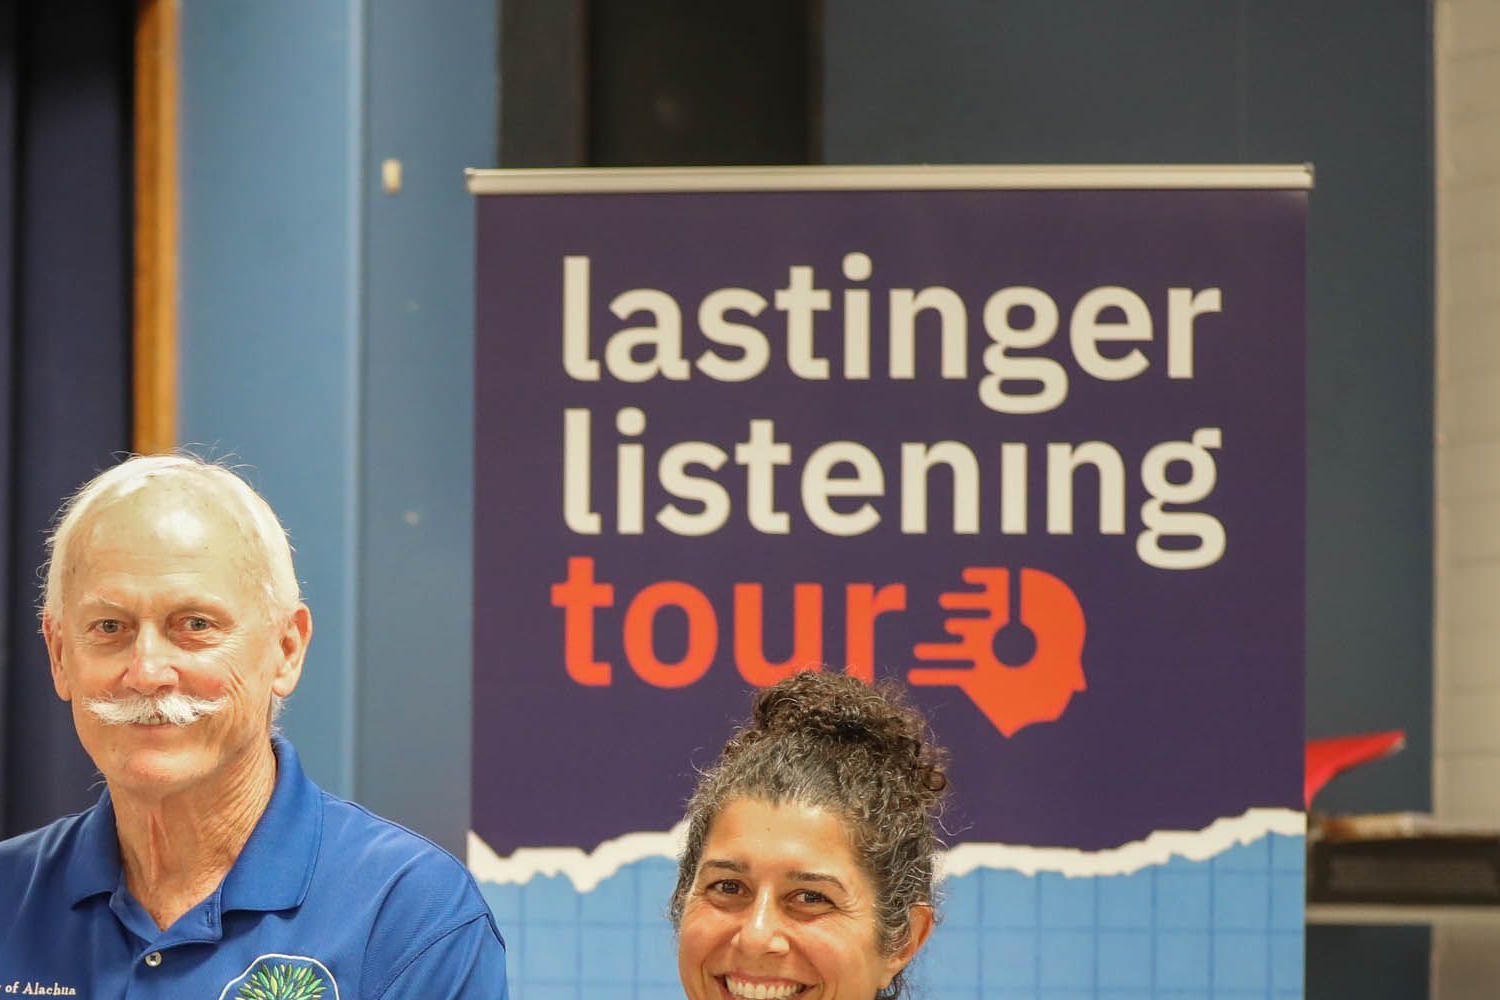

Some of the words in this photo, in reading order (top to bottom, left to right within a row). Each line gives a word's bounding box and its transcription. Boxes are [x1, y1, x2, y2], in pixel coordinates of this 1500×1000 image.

[562, 252, 1222, 414] lastinger
[562, 406, 1227, 570] listening
[551, 556, 907, 688] tour
[5, 981, 20, 993] of
[22, 981, 77, 996] Alachua
